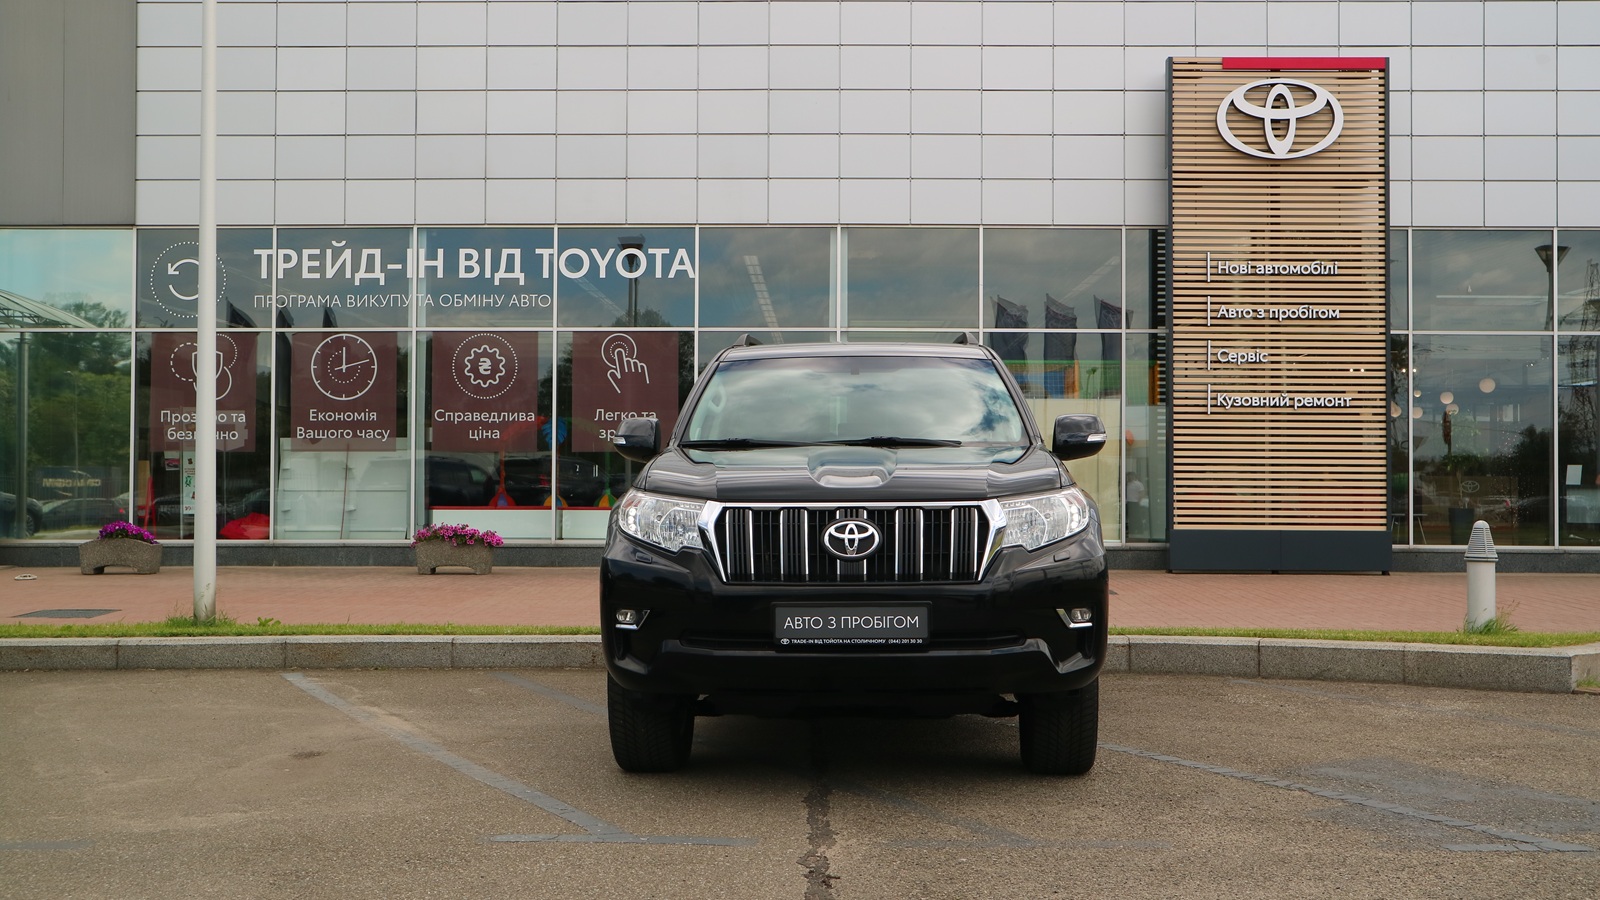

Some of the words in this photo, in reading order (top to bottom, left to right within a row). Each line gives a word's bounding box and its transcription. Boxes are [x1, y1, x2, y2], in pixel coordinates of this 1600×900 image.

[253, 240, 444, 286] ТРЕЙД-ІН
[458, 248, 525, 286] ВІД
[535, 248, 696, 279] TOYOTA
[1217, 261, 1252, 275] Нові
[1256, 261, 1338, 275] автомобілі
[254, 294, 342, 308] ПРОГРАМА
[346, 294, 412, 308] ВИКУПУ
[415, 294, 435, 307] ТА
[439, 294, 505, 308] ОБМІНУ
[509, 294, 552, 308] АВТО
[1217, 305, 1253, 319] Авто
[1256, 308, 1266, 318] з
[1269, 305, 1340, 322] пробігом
[1217, 349, 1269, 365] Сервіс
[1217, 393, 1290, 409] Кузовний
[1294, 396, 1352, 410] ремонт
[160, 410, 227, 426] Прозо
[231, 413, 246, 423] та
[309, 408, 377, 421] Економія
[434, 409, 535, 424] Справедлива
[594, 408, 637, 421] Легко
[296, 426, 353, 439] Вашого
[356, 429, 390, 442] часу
[469, 426, 500, 441] ціна
[783, 616, 823, 629] АВТО
[841, 615, 919, 629] ПРОБІГОМ
